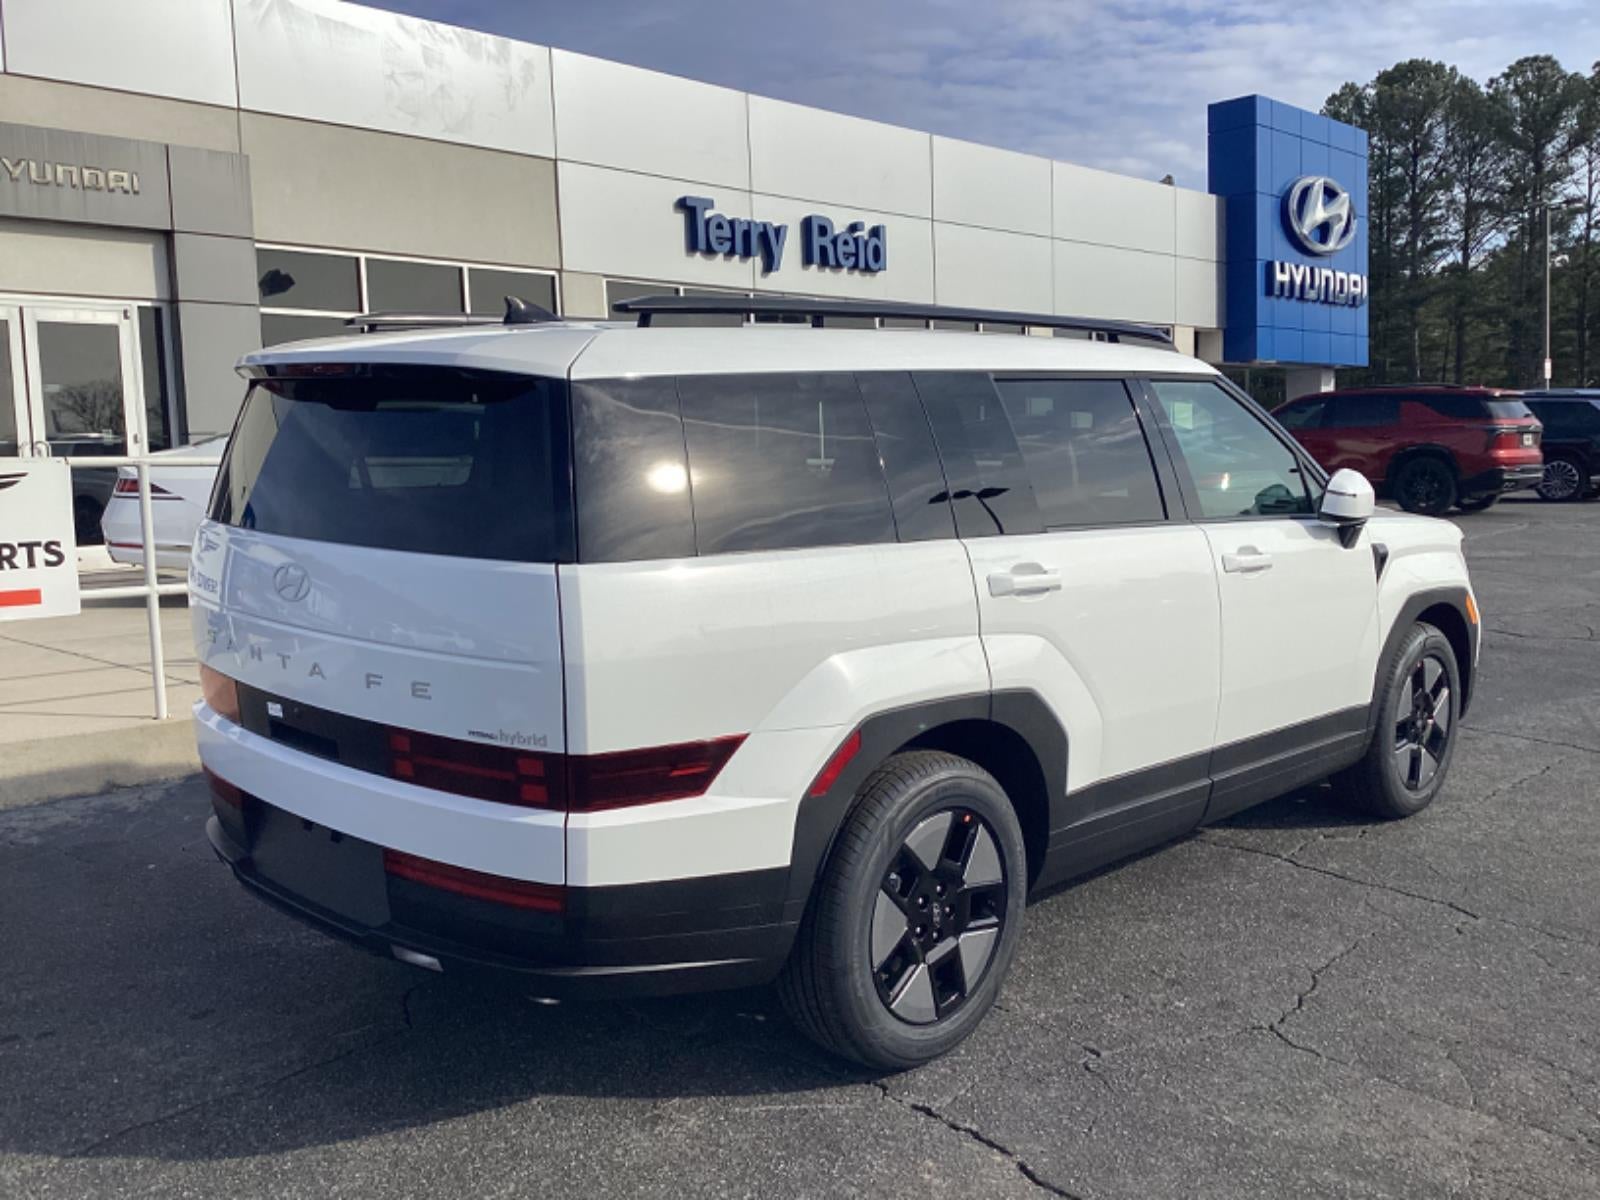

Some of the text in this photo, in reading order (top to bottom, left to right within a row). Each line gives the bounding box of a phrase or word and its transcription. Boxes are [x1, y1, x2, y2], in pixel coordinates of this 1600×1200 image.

[674, 195, 887, 273] Terry Reid
[1266, 260, 1367, 307] HYUNDAI
[365, 672, 432, 700] FE
[499, 729, 547, 747] hybrid
